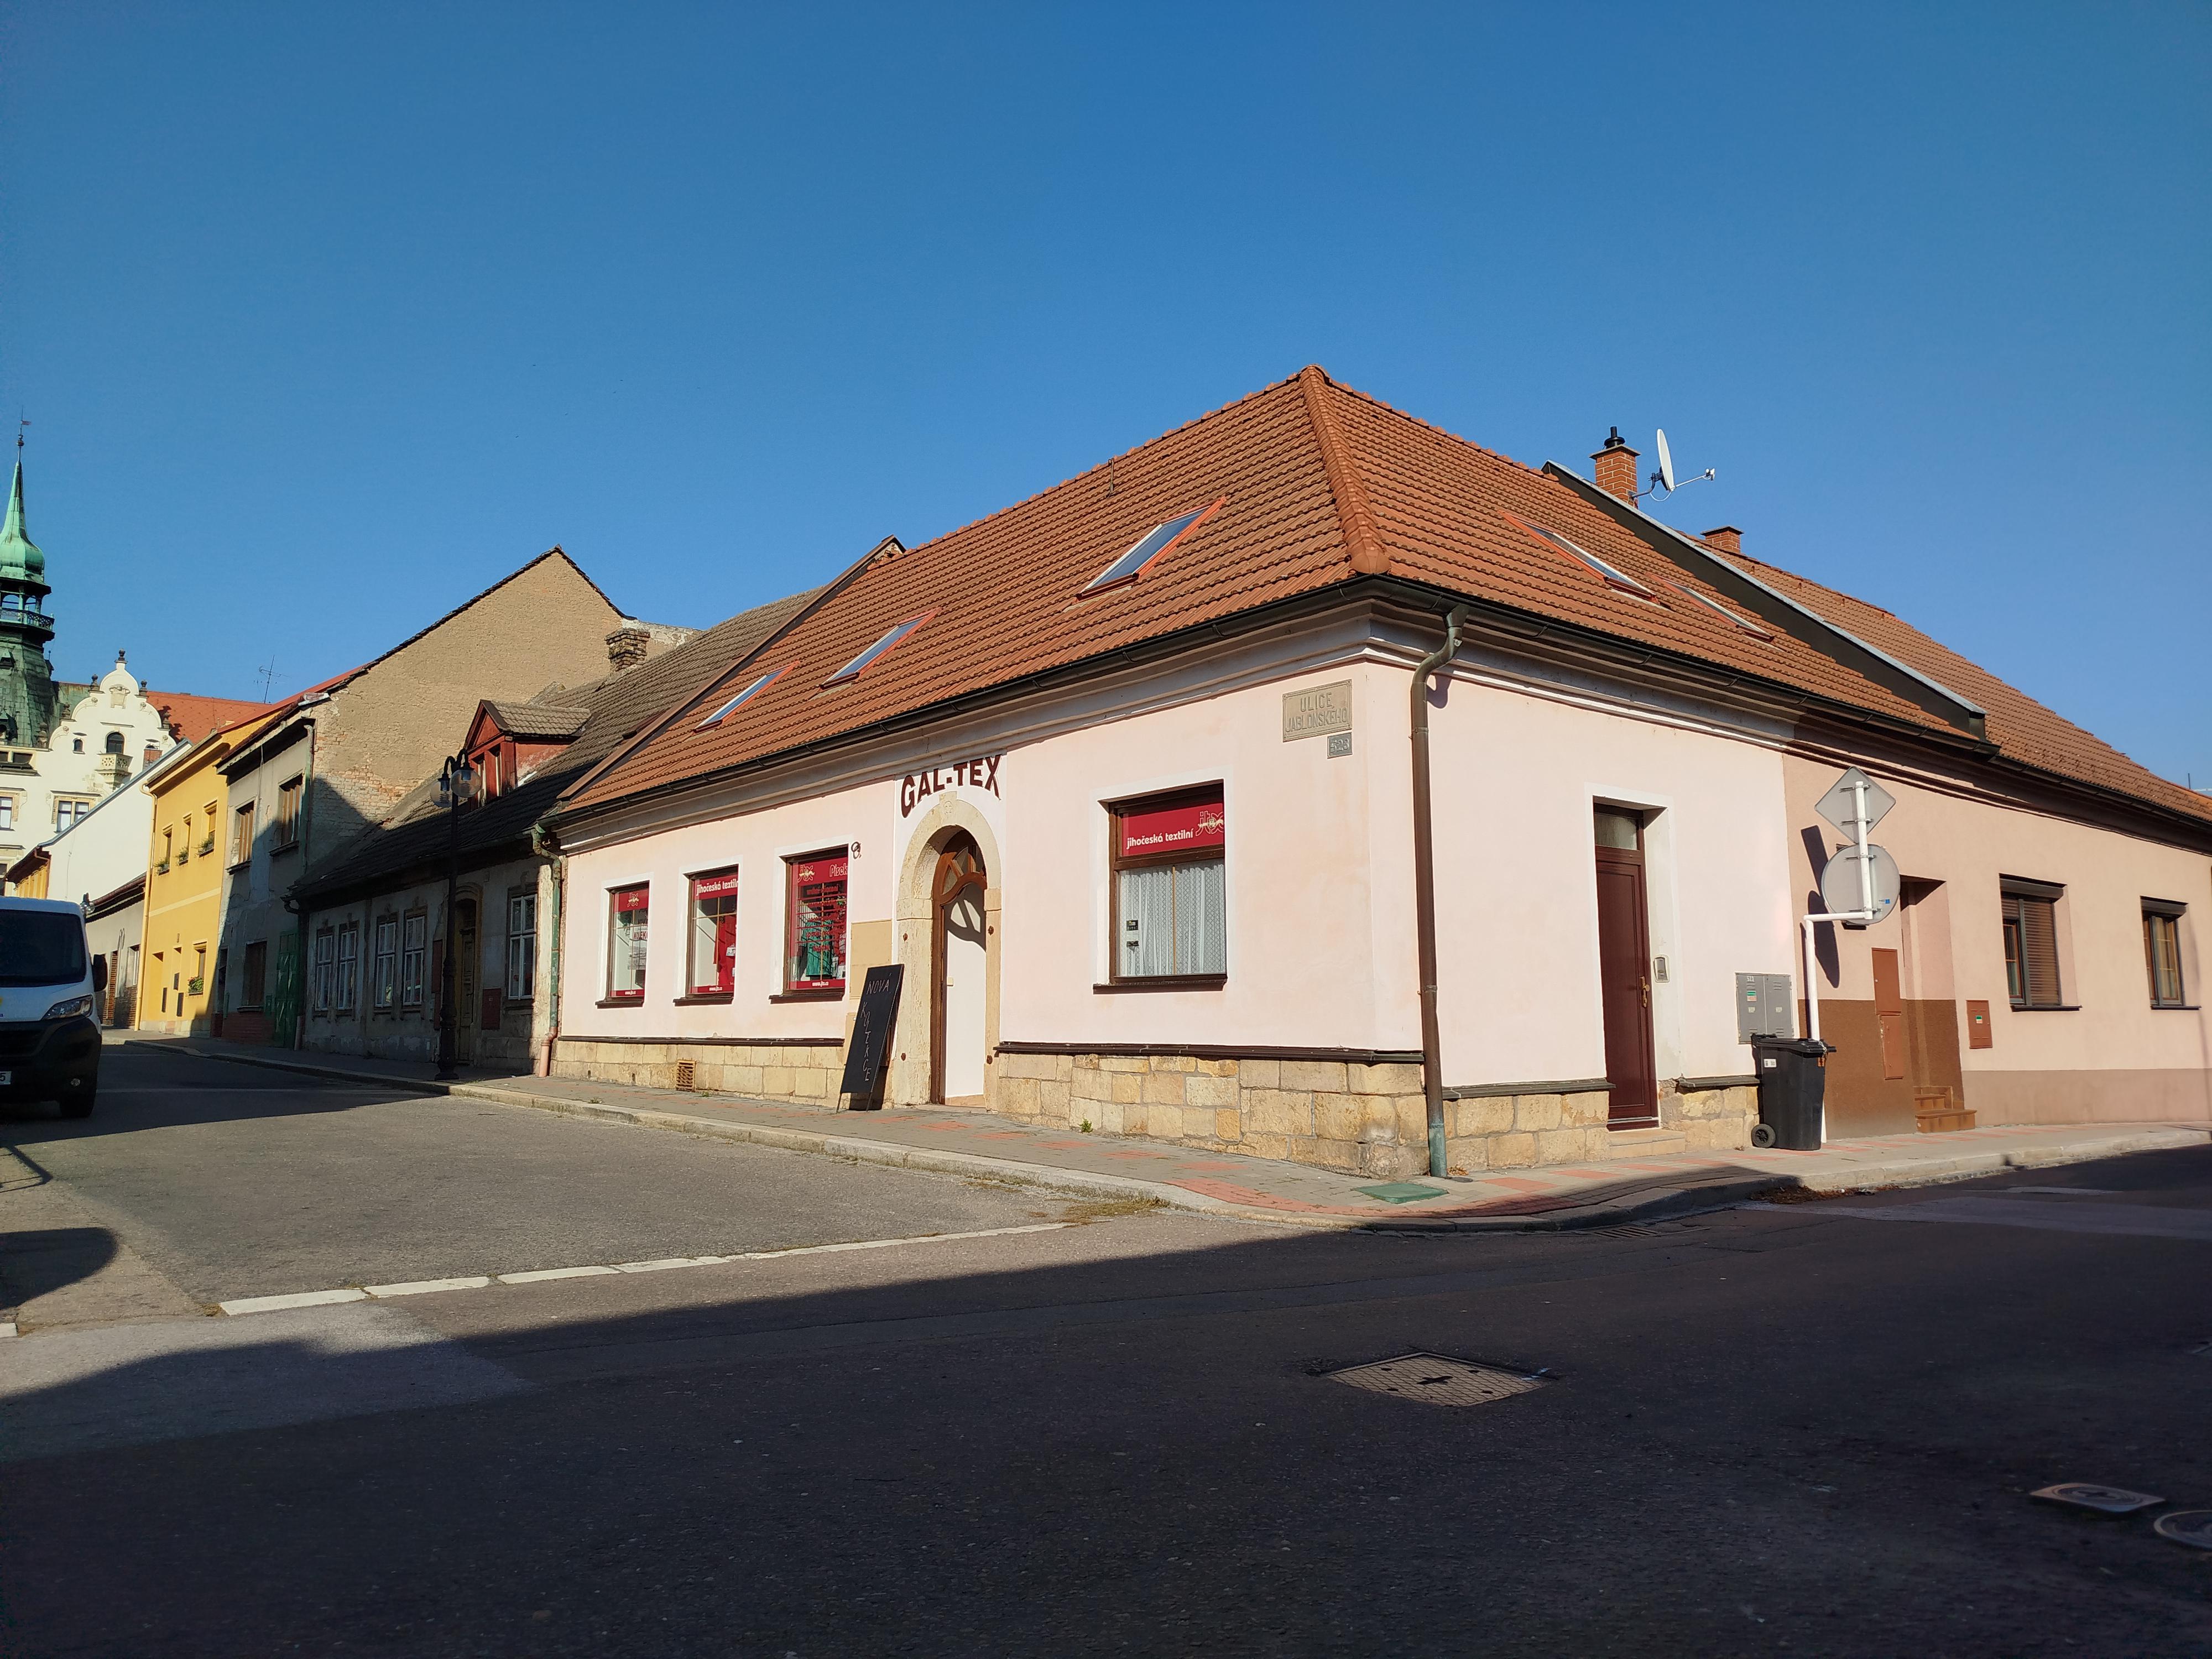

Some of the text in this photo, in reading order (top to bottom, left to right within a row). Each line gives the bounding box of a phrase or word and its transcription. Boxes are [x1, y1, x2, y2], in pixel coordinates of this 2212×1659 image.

[1300, 692, 1332, 712] ULICE
[1330, 738, 1350, 753] 523
[901, 754, 1001, 818] GAL-TEX
[1126, 828, 1194, 850] jihočeská textilní
[696, 880, 721, 896] jihočeská
